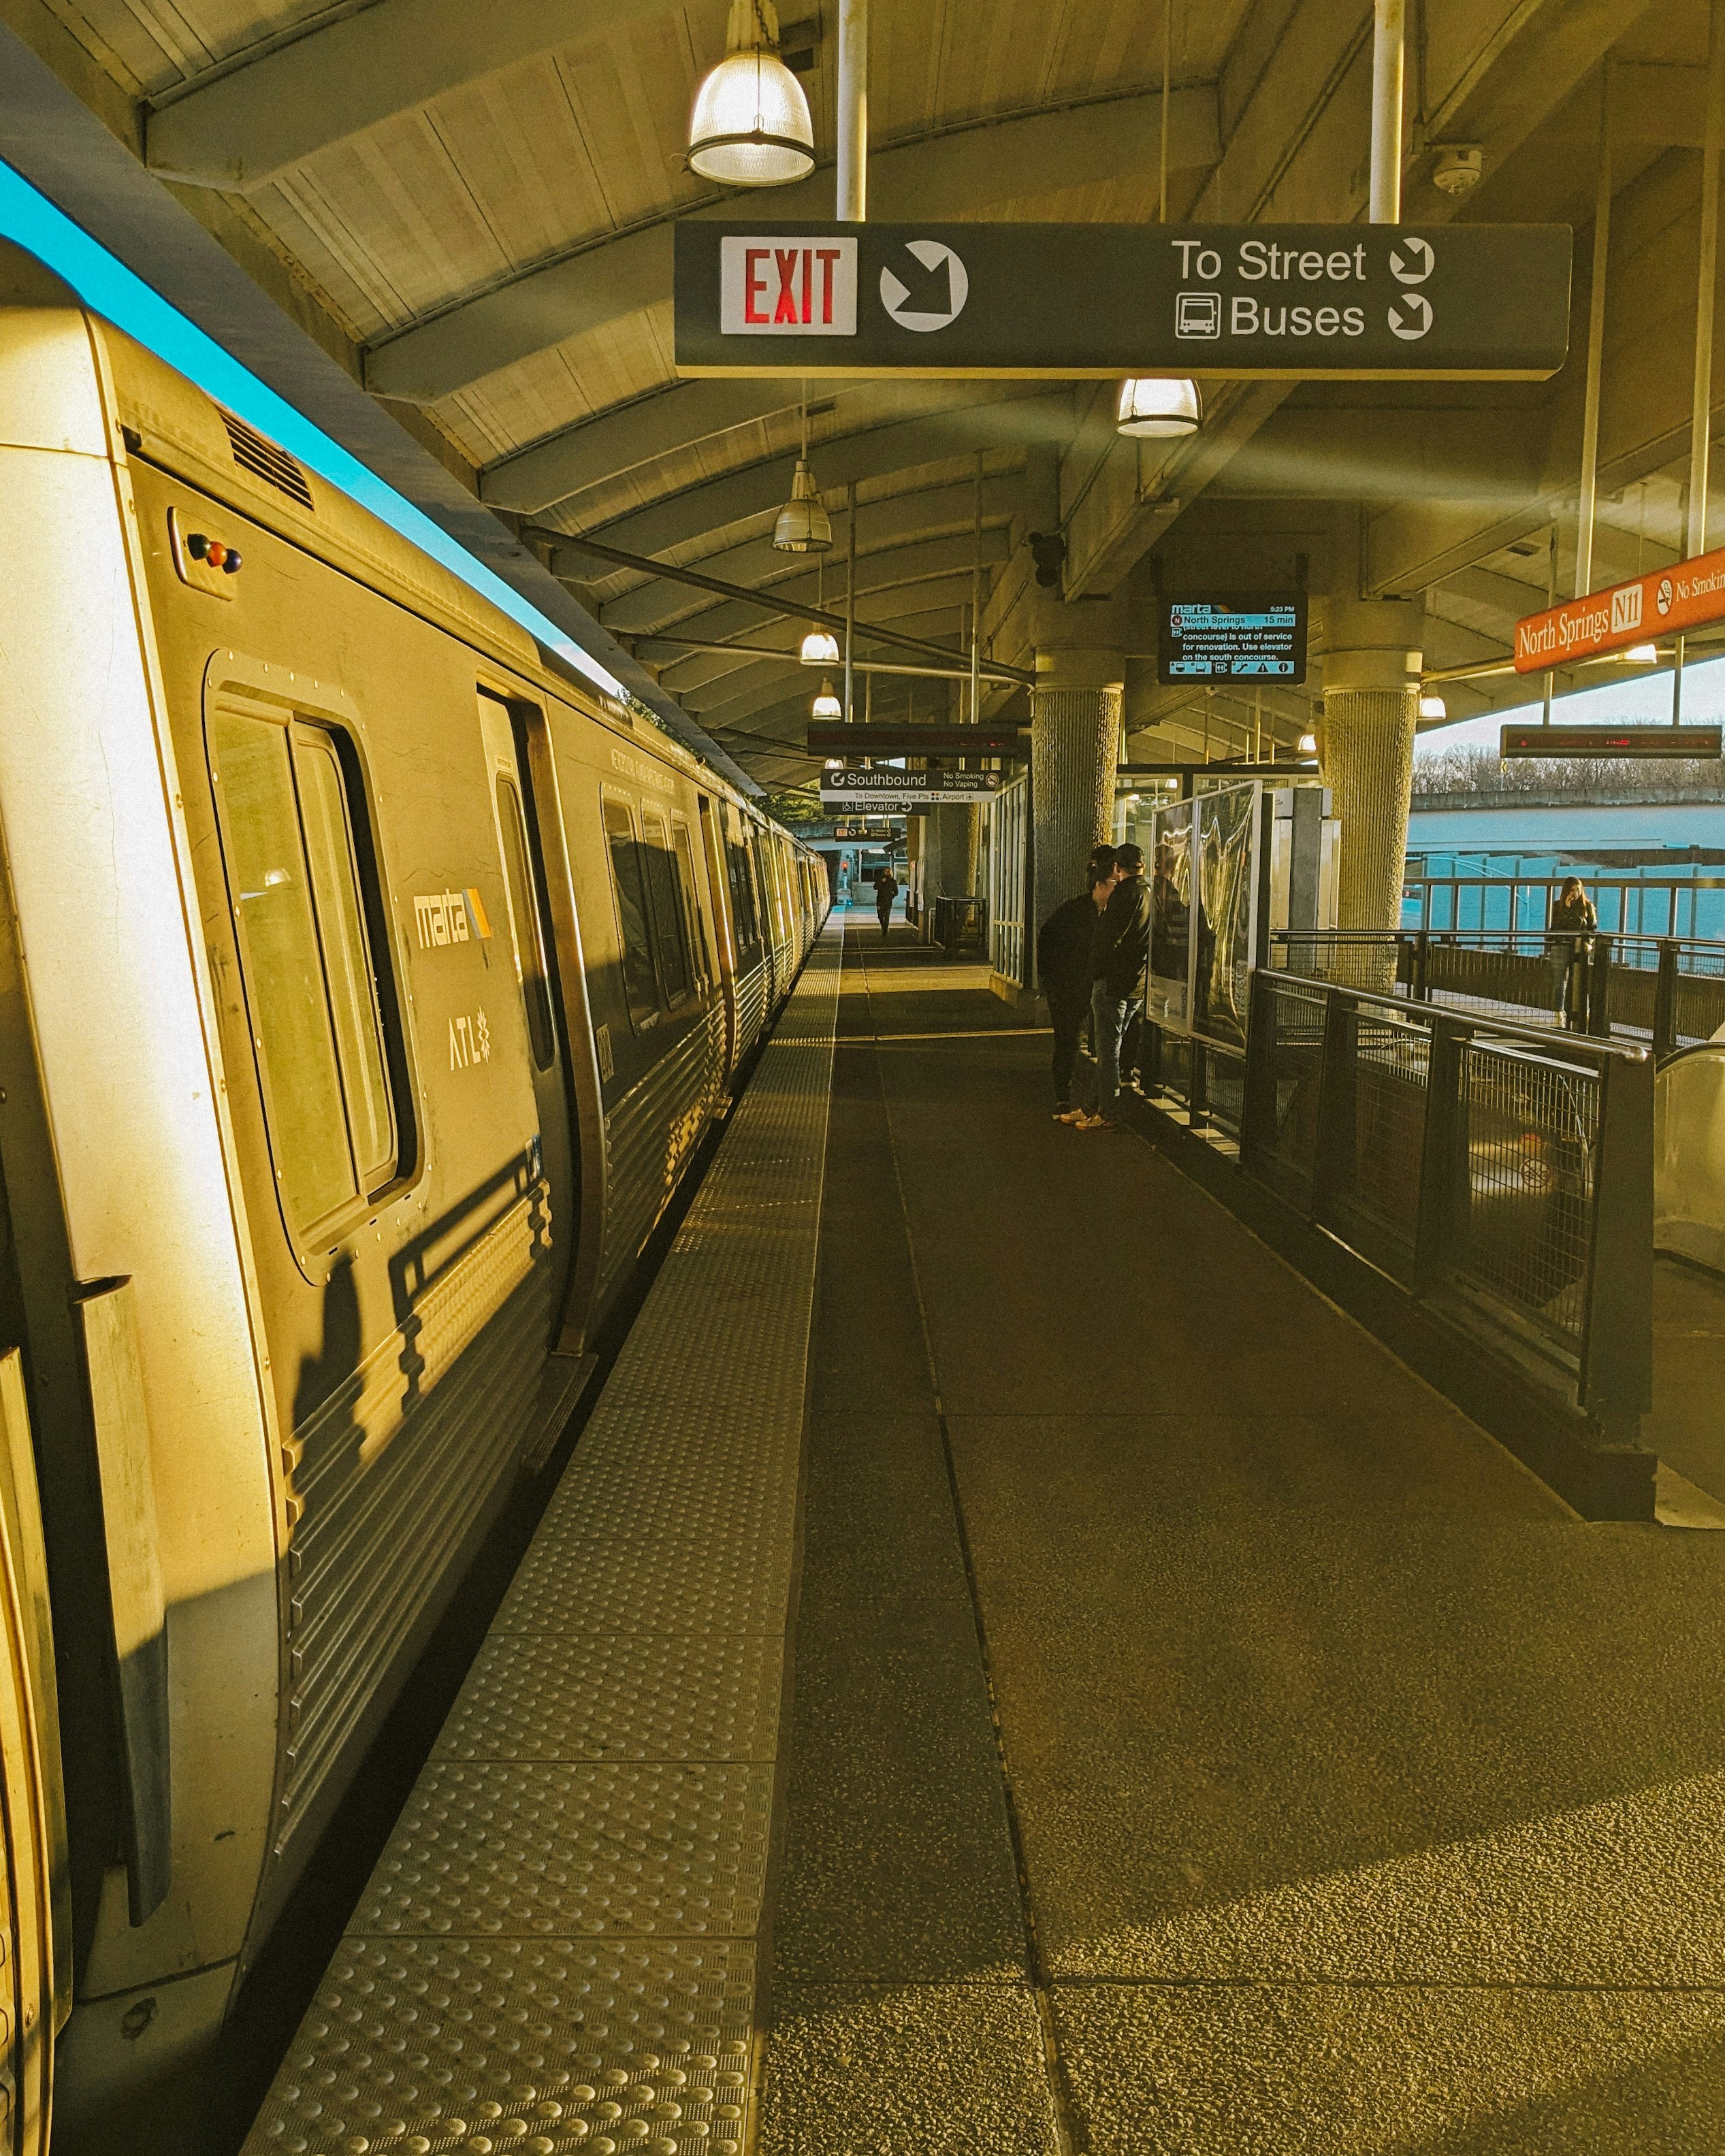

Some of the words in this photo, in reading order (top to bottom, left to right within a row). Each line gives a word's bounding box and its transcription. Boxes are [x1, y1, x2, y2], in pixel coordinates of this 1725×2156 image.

[1172, 240, 1222, 280] To
[1238, 240, 1366, 280] Street
[745, 248, 841, 324] EXIT
[1231, 297, 1365, 336] Buses
[1676, 581, 1690, 602] No
[1692, 570, 1725, 597] Smokin
[1172, 604, 1212, 614] marta
[1212, 616, 1246, 625] Springs
[1518, 617, 1556, 658] North
[1559, 606, 1609, 651] Springs
[1614, 589, 1639, 627] N11
[1182, 633, 1227, 642] concourse)
[847, 773, 926, 786] Southbound
[955, 772, 984, 781] Smoking
[855, 802, 899, 811] Elevator
[413, 887, 470, 949] marta
[449, 1015, 482, 1071] ATL
